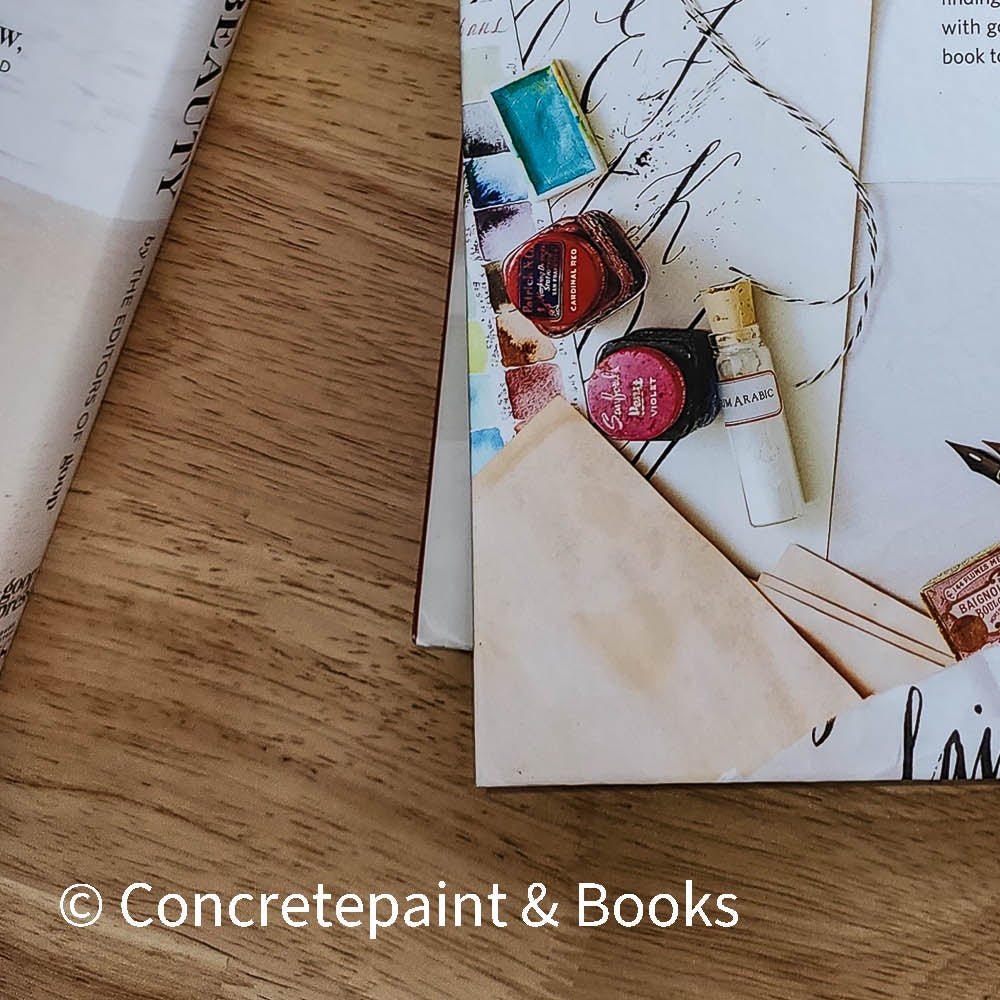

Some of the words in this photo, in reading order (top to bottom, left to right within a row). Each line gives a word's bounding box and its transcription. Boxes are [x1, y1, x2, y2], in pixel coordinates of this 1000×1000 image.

[941, 17, 981, 36] with
[942, 47, 986, 65] book
[121, 266, 145, 308] THE
[84, 314, 127, 407] EDITORS
[649, 376, 658, 417] VIOLET
[734, 388, 775, 408] ARABIC
[73, 412, 89, 443] OF
